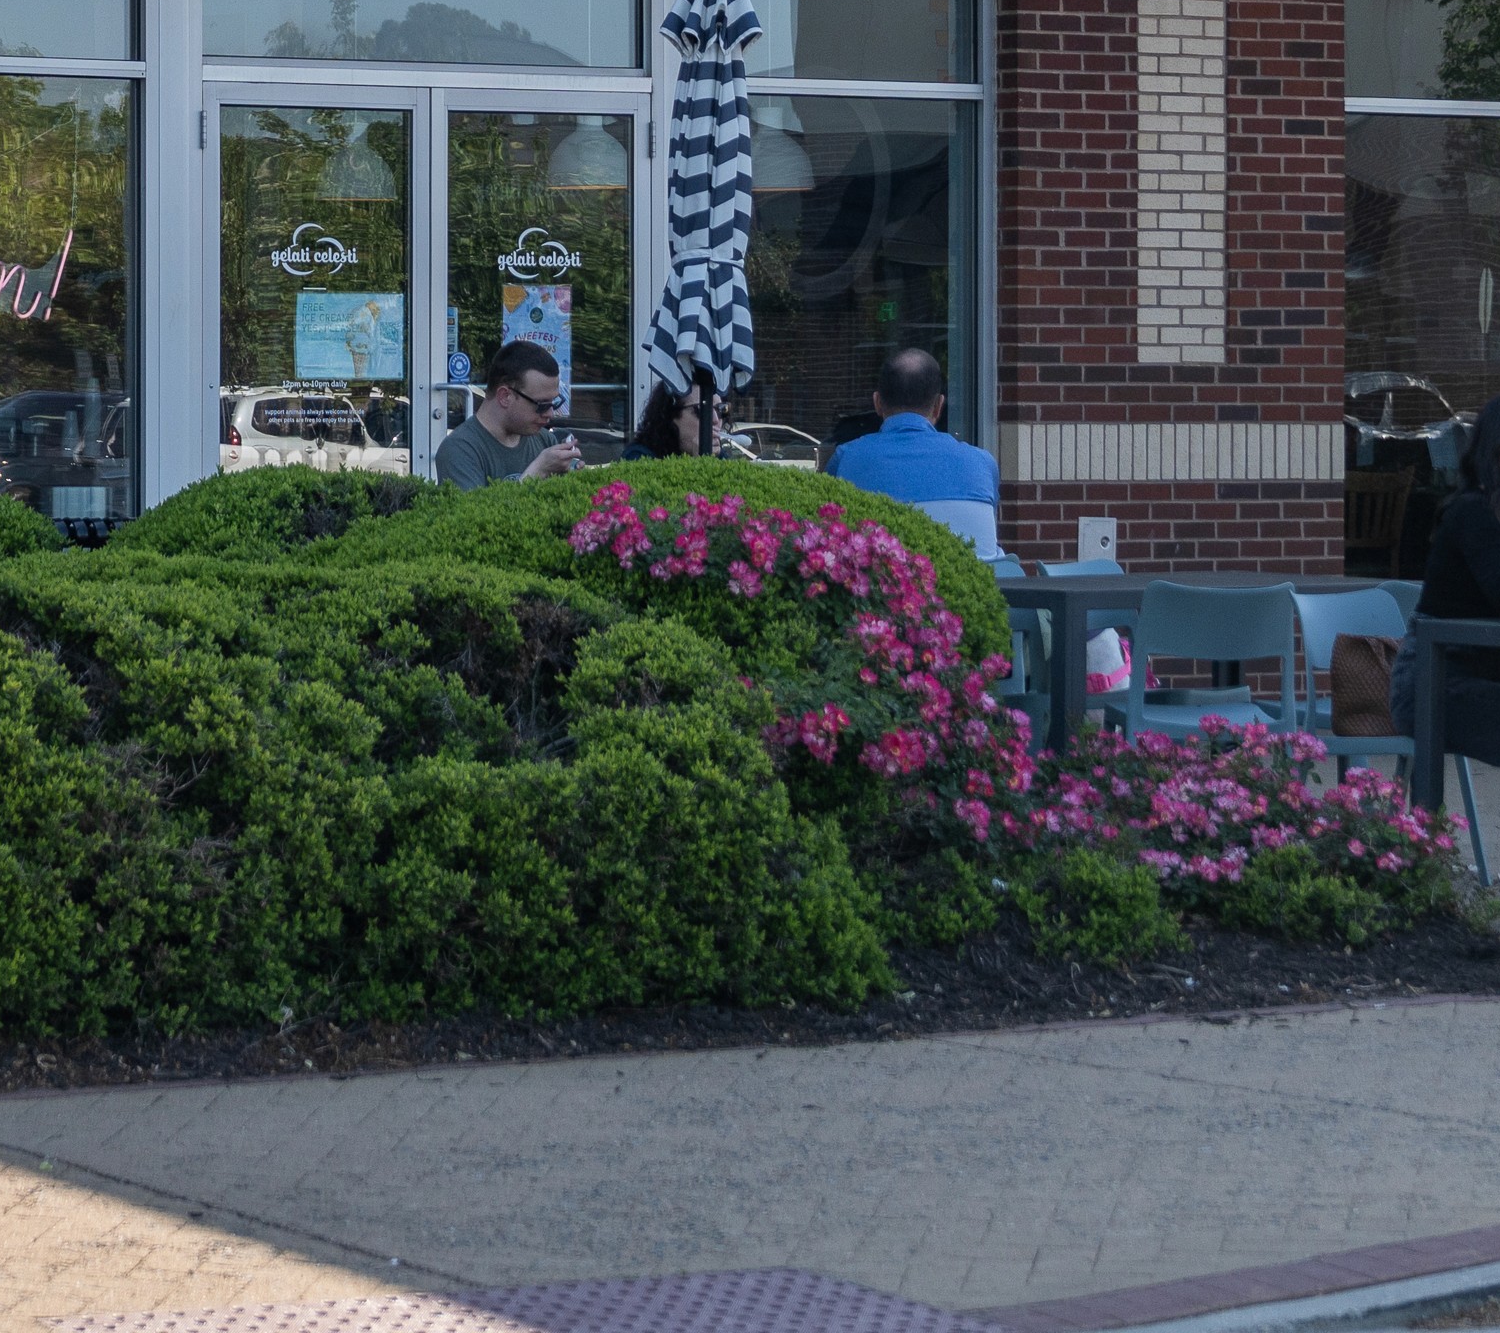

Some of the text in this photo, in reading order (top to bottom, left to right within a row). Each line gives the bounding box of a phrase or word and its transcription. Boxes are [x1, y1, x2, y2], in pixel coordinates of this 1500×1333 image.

[271, 246, 359, 268] gelati celesti
[497, 251, 582, 271] gelati celesti
[302, 302, 325, 312] FREE
[331, 380, 348, 389] daily
